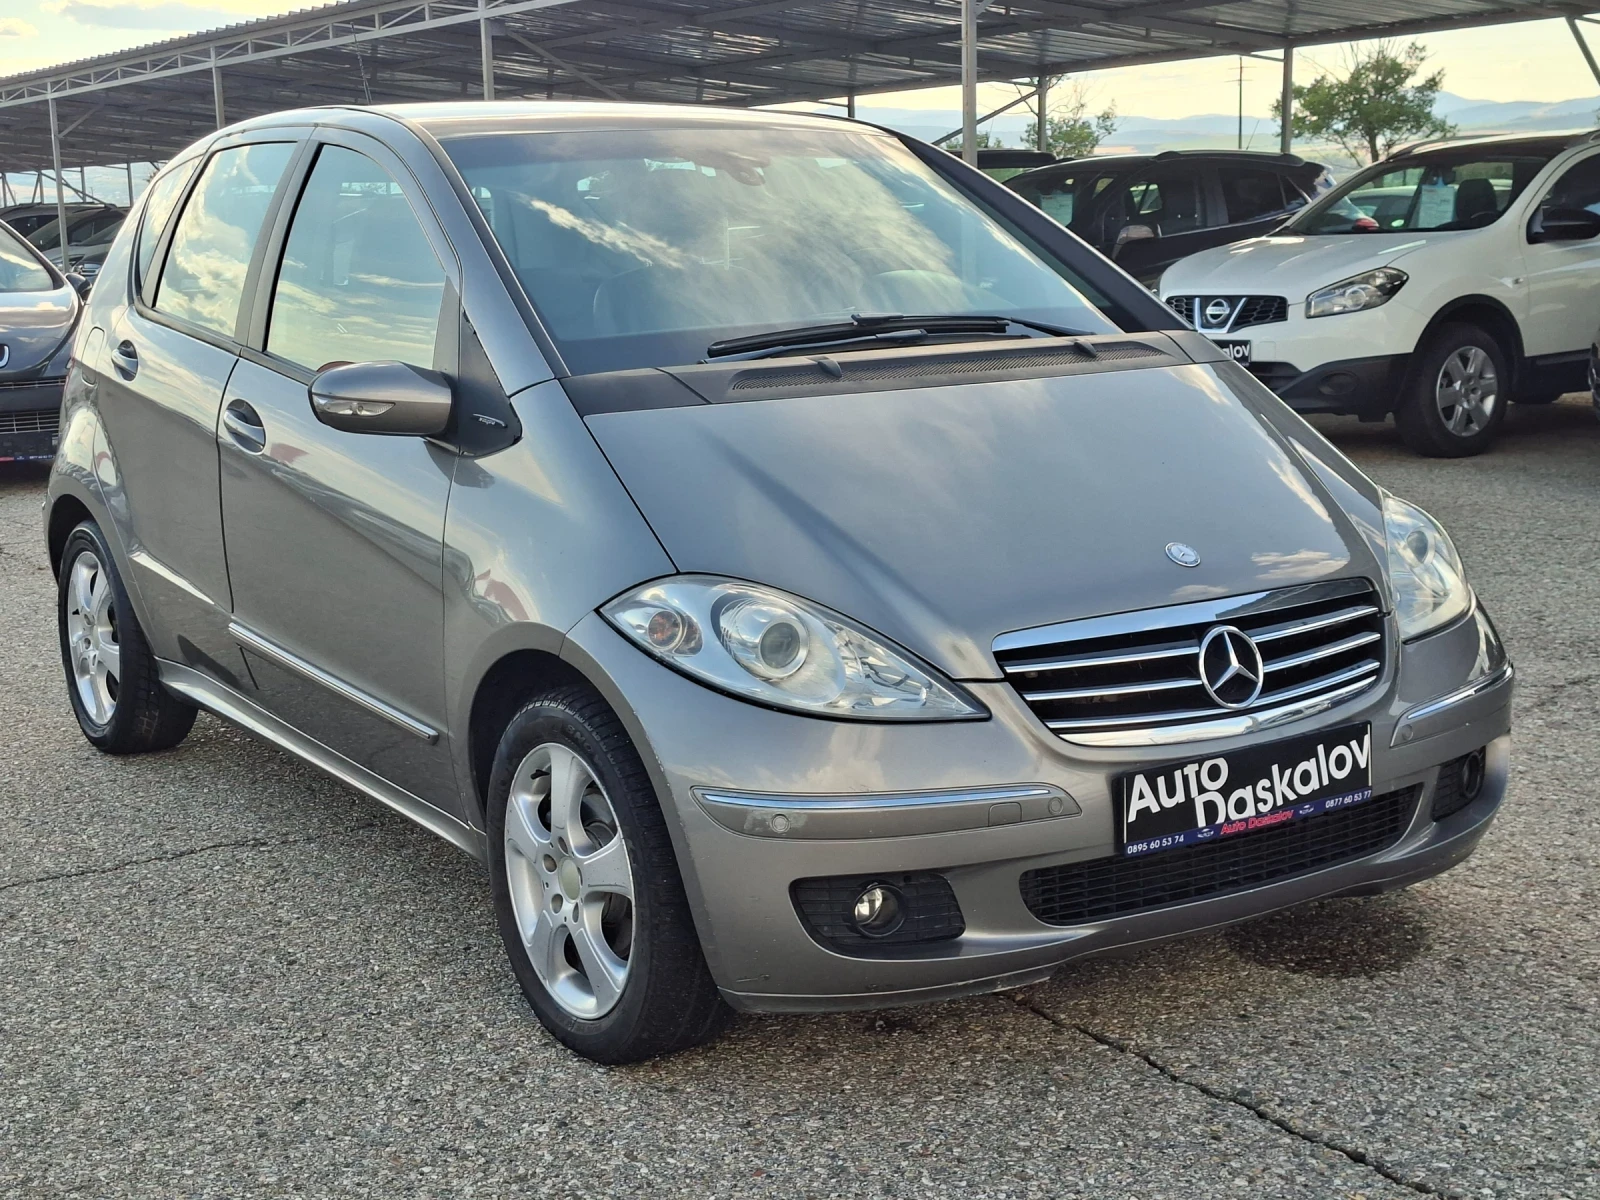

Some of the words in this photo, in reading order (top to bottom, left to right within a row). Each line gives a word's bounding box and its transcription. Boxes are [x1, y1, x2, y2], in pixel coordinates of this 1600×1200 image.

[1194, 733, 1370, 828] Daskalov
[1325, 797, 1342, 809] 0877
[1343, 795, 1353, 804] 60
[1353, 792, 1363, 801] 53
[1363, 790, 1372, 799] 77
[1220, 820, 1247, 835] Auto
[1248, 809, 1294, 829] Daskalov
[1127, 842, 1148, 854] 0895
[1149, 839, 1160, 850] 60
[1162, 838, 1172, 847] 53
[1174, 834, 1184, 844] 74
